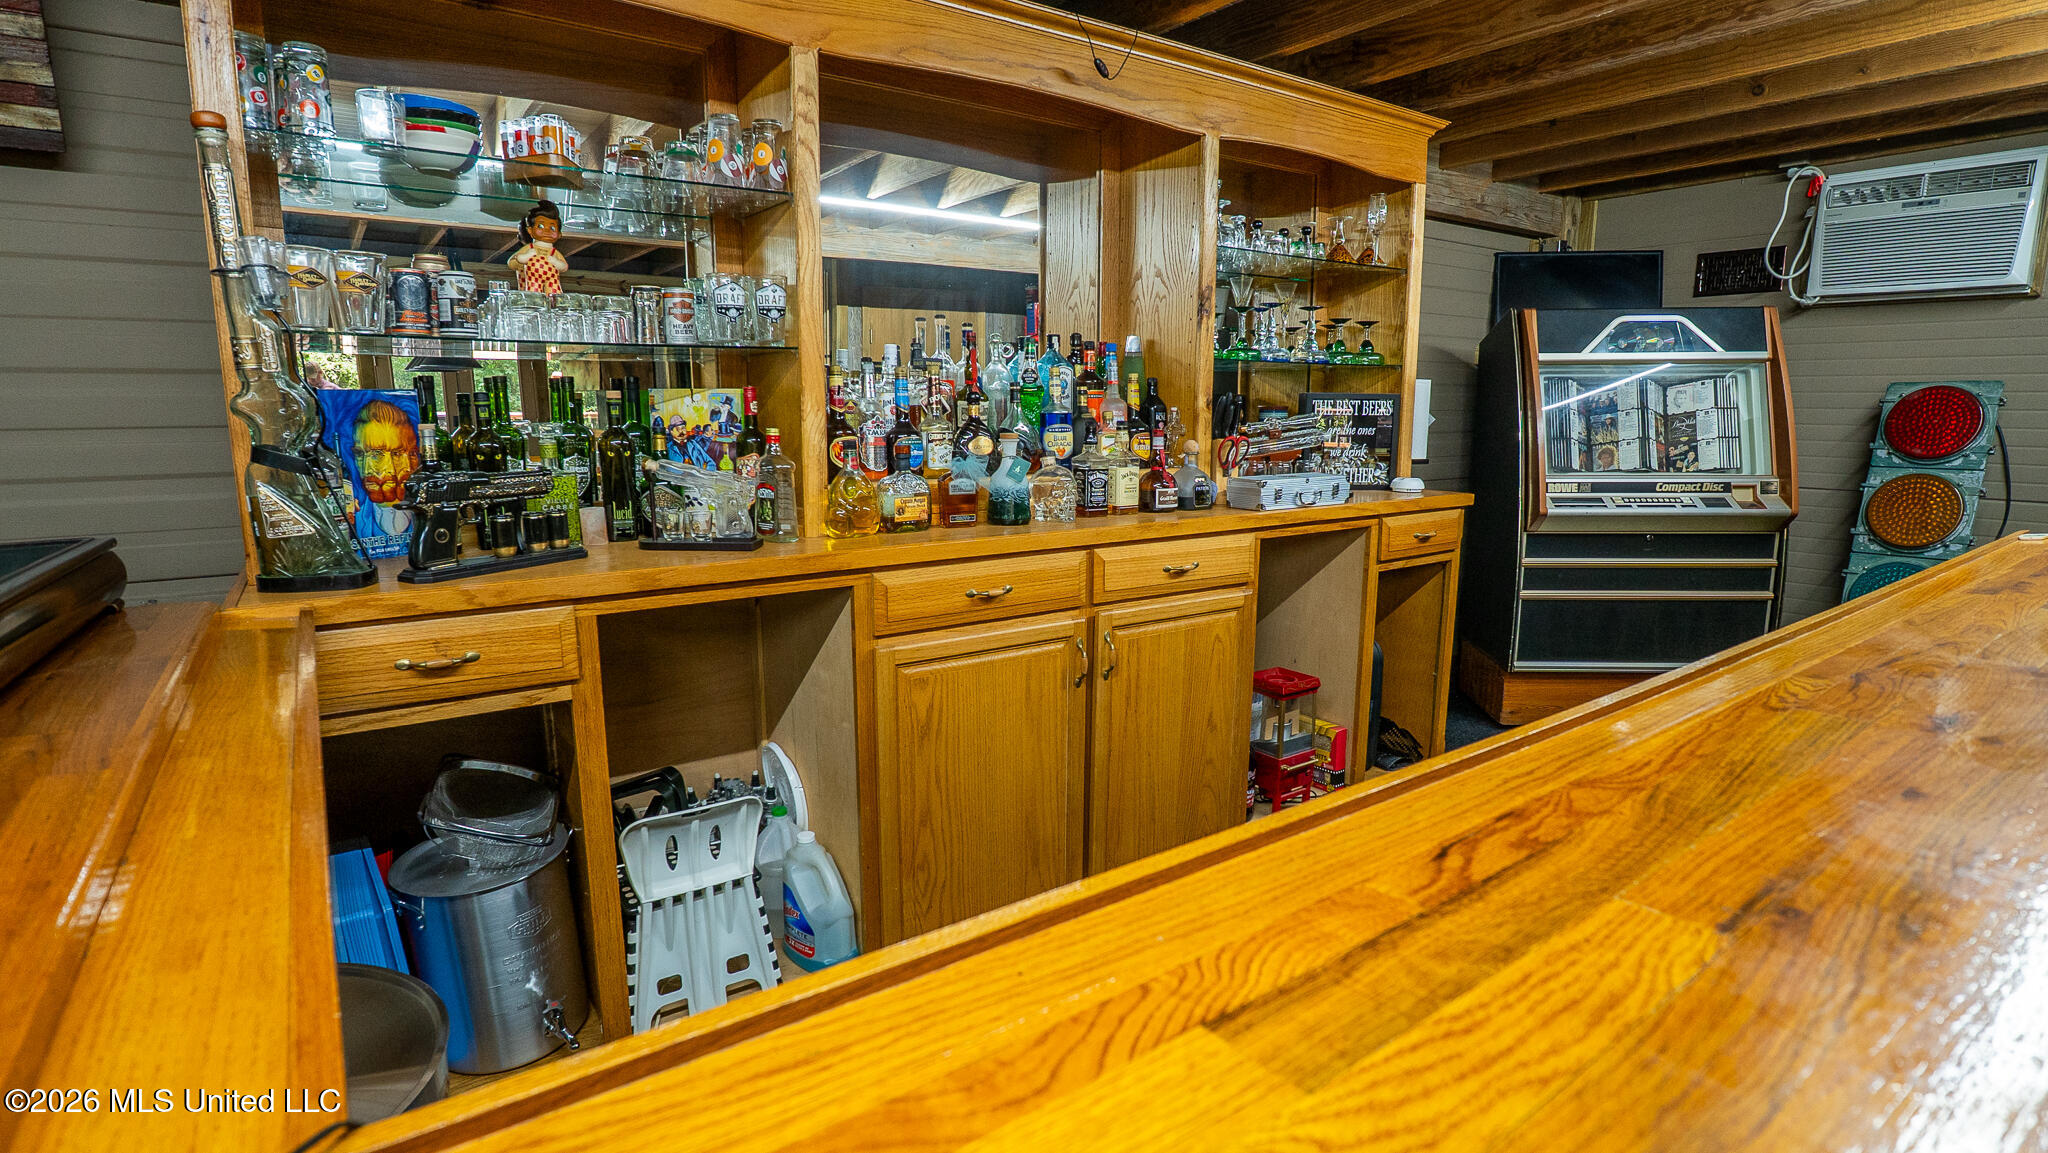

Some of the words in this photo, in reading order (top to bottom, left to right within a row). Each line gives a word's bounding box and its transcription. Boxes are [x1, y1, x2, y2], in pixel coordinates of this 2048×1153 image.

[1312, 399, 1334, 416] THE
[1336, 399, 1360, 416] BEST
[1362, 399, 1394, 416] BEERS
[1343, 422, 1356, 435] the
[1357, 427, 1377, 436] ones
[1330, 448, 1342, 457] we
[1342, 443, 1368, 457] drink
[1547, 482, 1579, 493] ROWE
[1655, 482, 1701, 494] Compact
[1702, 482, 1724, 492] Disc
